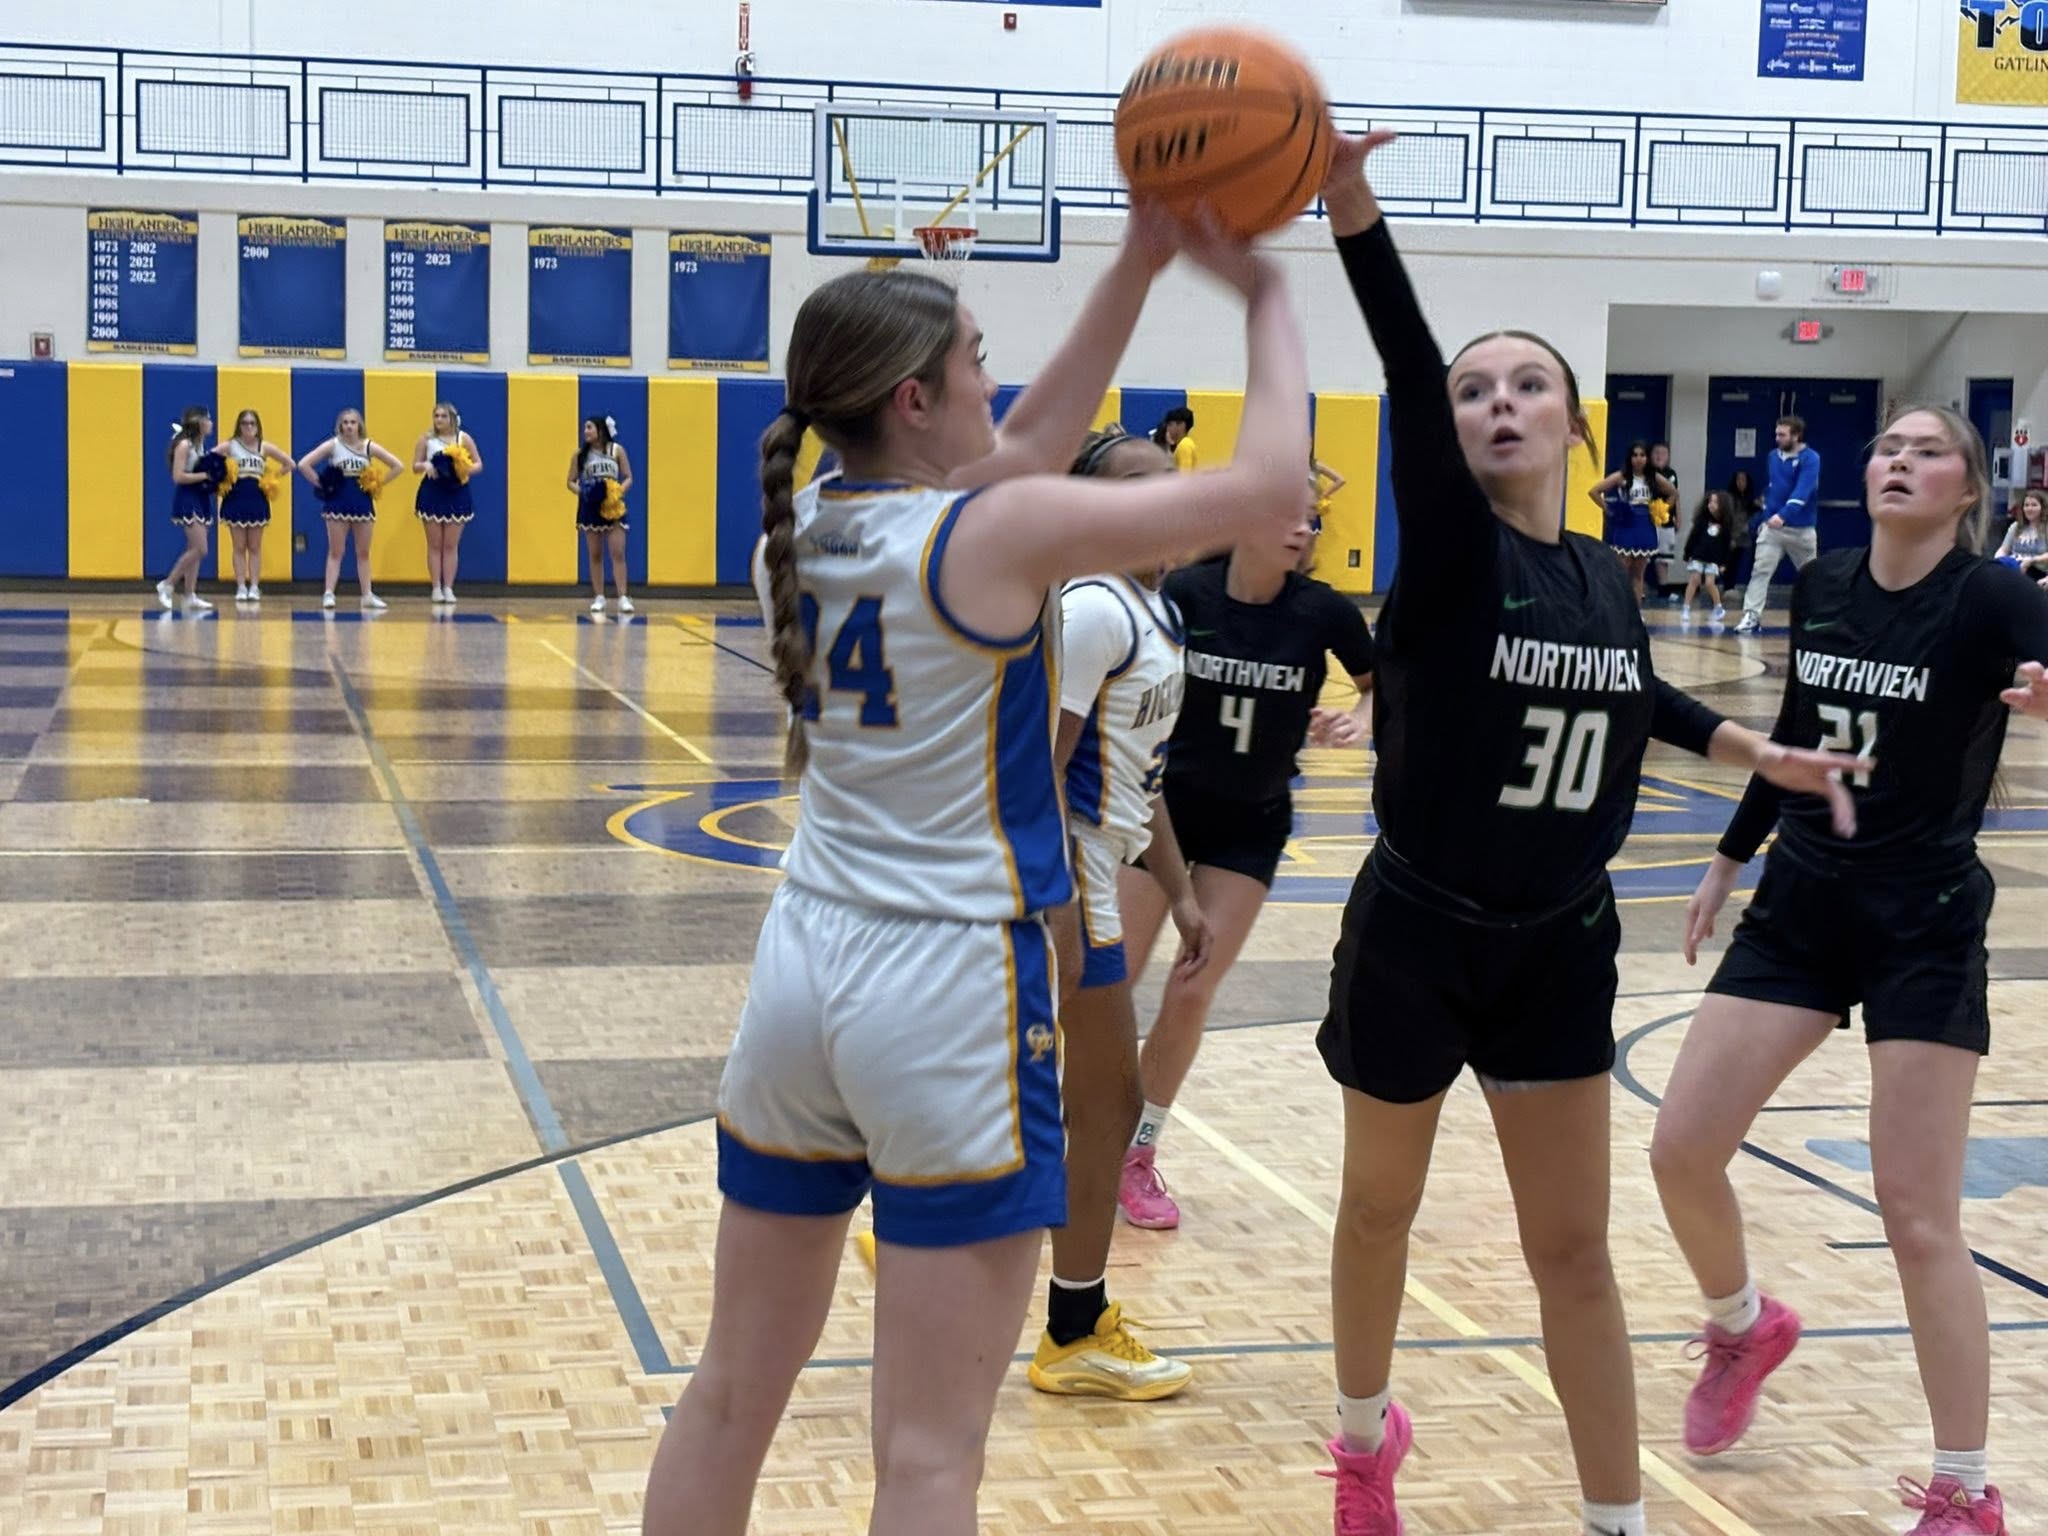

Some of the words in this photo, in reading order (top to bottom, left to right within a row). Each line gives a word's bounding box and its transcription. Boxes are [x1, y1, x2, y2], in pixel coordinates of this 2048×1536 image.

[98, 216, 188, 232] HIGHLANDERS
[248, 222, 337, 237] HIGHLANDERS
[395, 228, 481, 242] HIGHLANDERS
[538, 233, 623, 248] HIGHLANDERS
[94, 240, 118, 253] 1973
[130, 241, 157, 254] 2002
[243, 246, 269, 259] 2000
[679, 239, 762, 254] HIGHLANDERS
[94, 254, 118, 267] 1974
[129, 256, 154, 268] 2021
[390, 252, 414, 265] 1970
[425, 253, 451, 266] 2023
[534, 257, 557, 269] 1973
[390, 266, 414, 278] 1972
[675, 261, 698, 273] 1973
[129, 270, 157, 283] 2022
[390, 280, 414, 292] 1973
[94, 311, 118, 324] 1999
[389, 308, 415, 321] 2000
[92, 326, 119, 338] 2000
[390, 322, 414, 335] 2001
[389, 336, 416, 349] 2022
[1186, 648, 1305, 692] NORTHVIEW
[1489, 634, 1642, 692] NORTHVIEW
[1796, 649, 1930, 702] NORTHVIEW
[1219, 694, 1257, 754] 4
[1816, 703, 1879, 788] 21
[1498, 705, 1609, 812] 30
